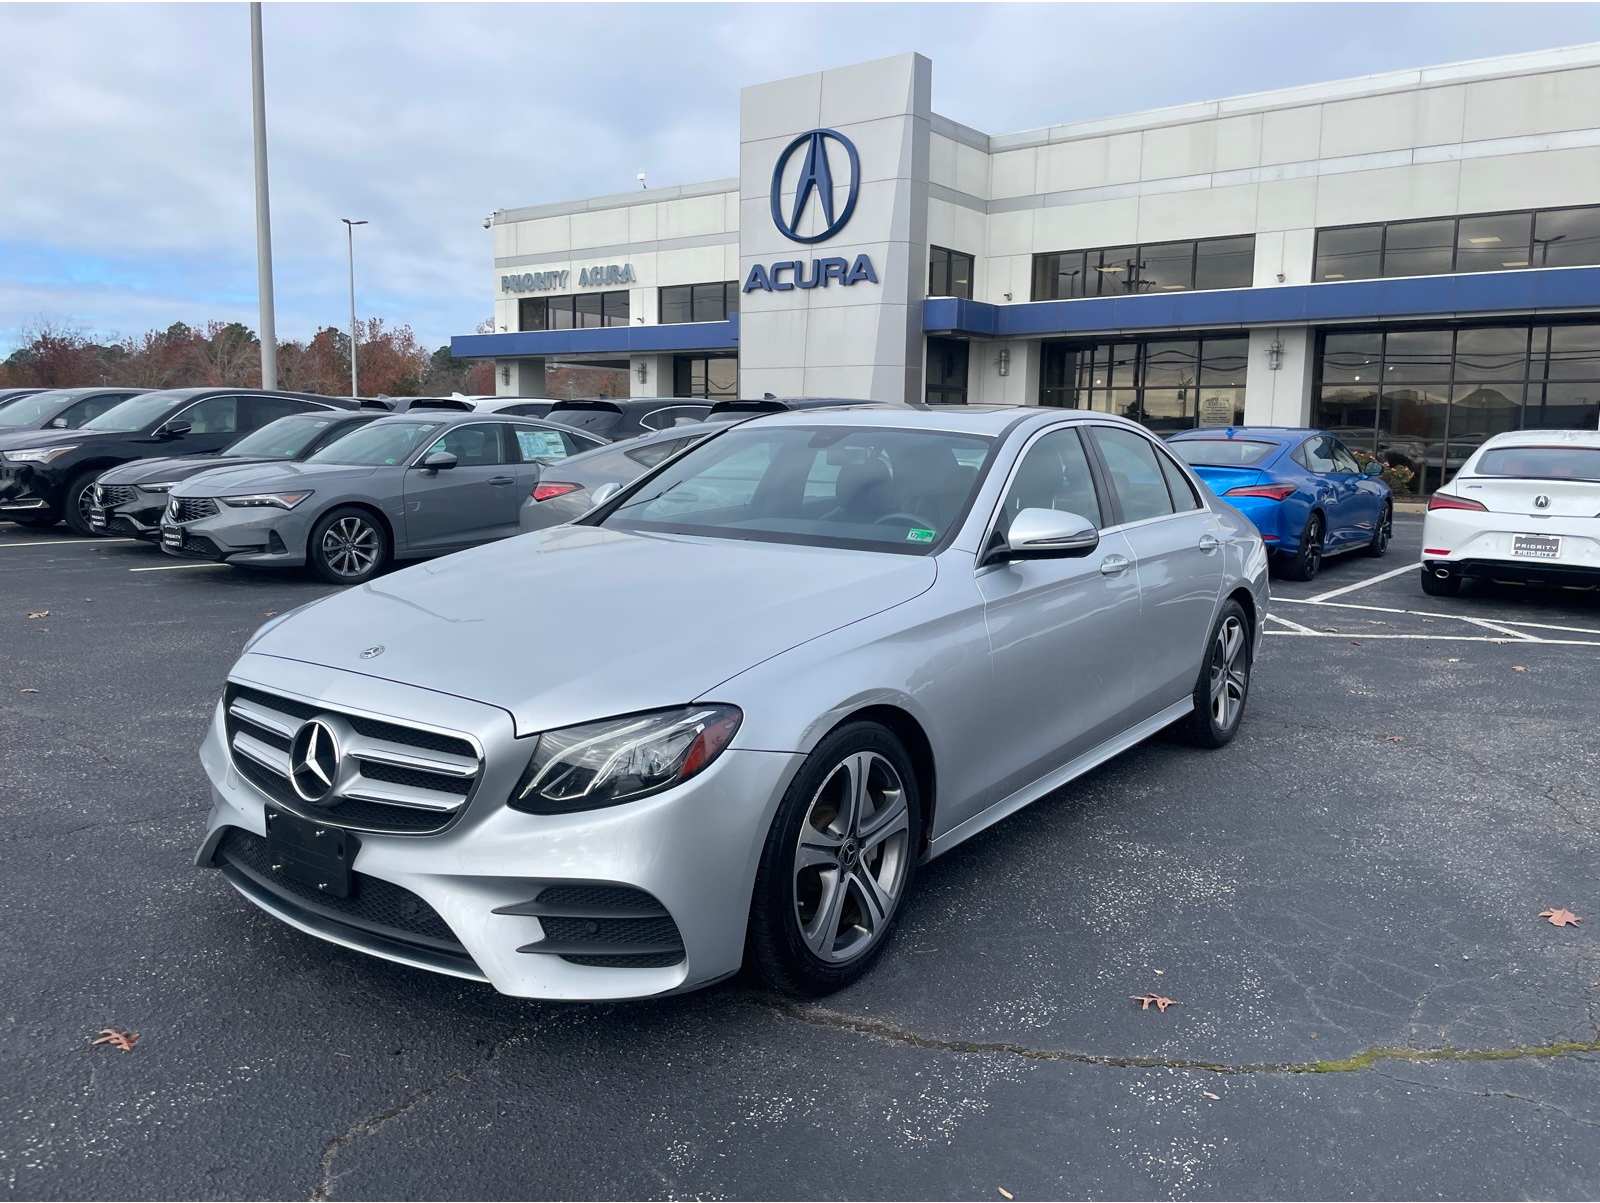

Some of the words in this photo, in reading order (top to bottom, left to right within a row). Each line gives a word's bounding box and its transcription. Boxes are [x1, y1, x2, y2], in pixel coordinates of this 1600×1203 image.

[501, 269, 569, 293] PRIORITY
[578, 263, 636, 287] ACURA
[742, 253, 878, 293] ACURA
